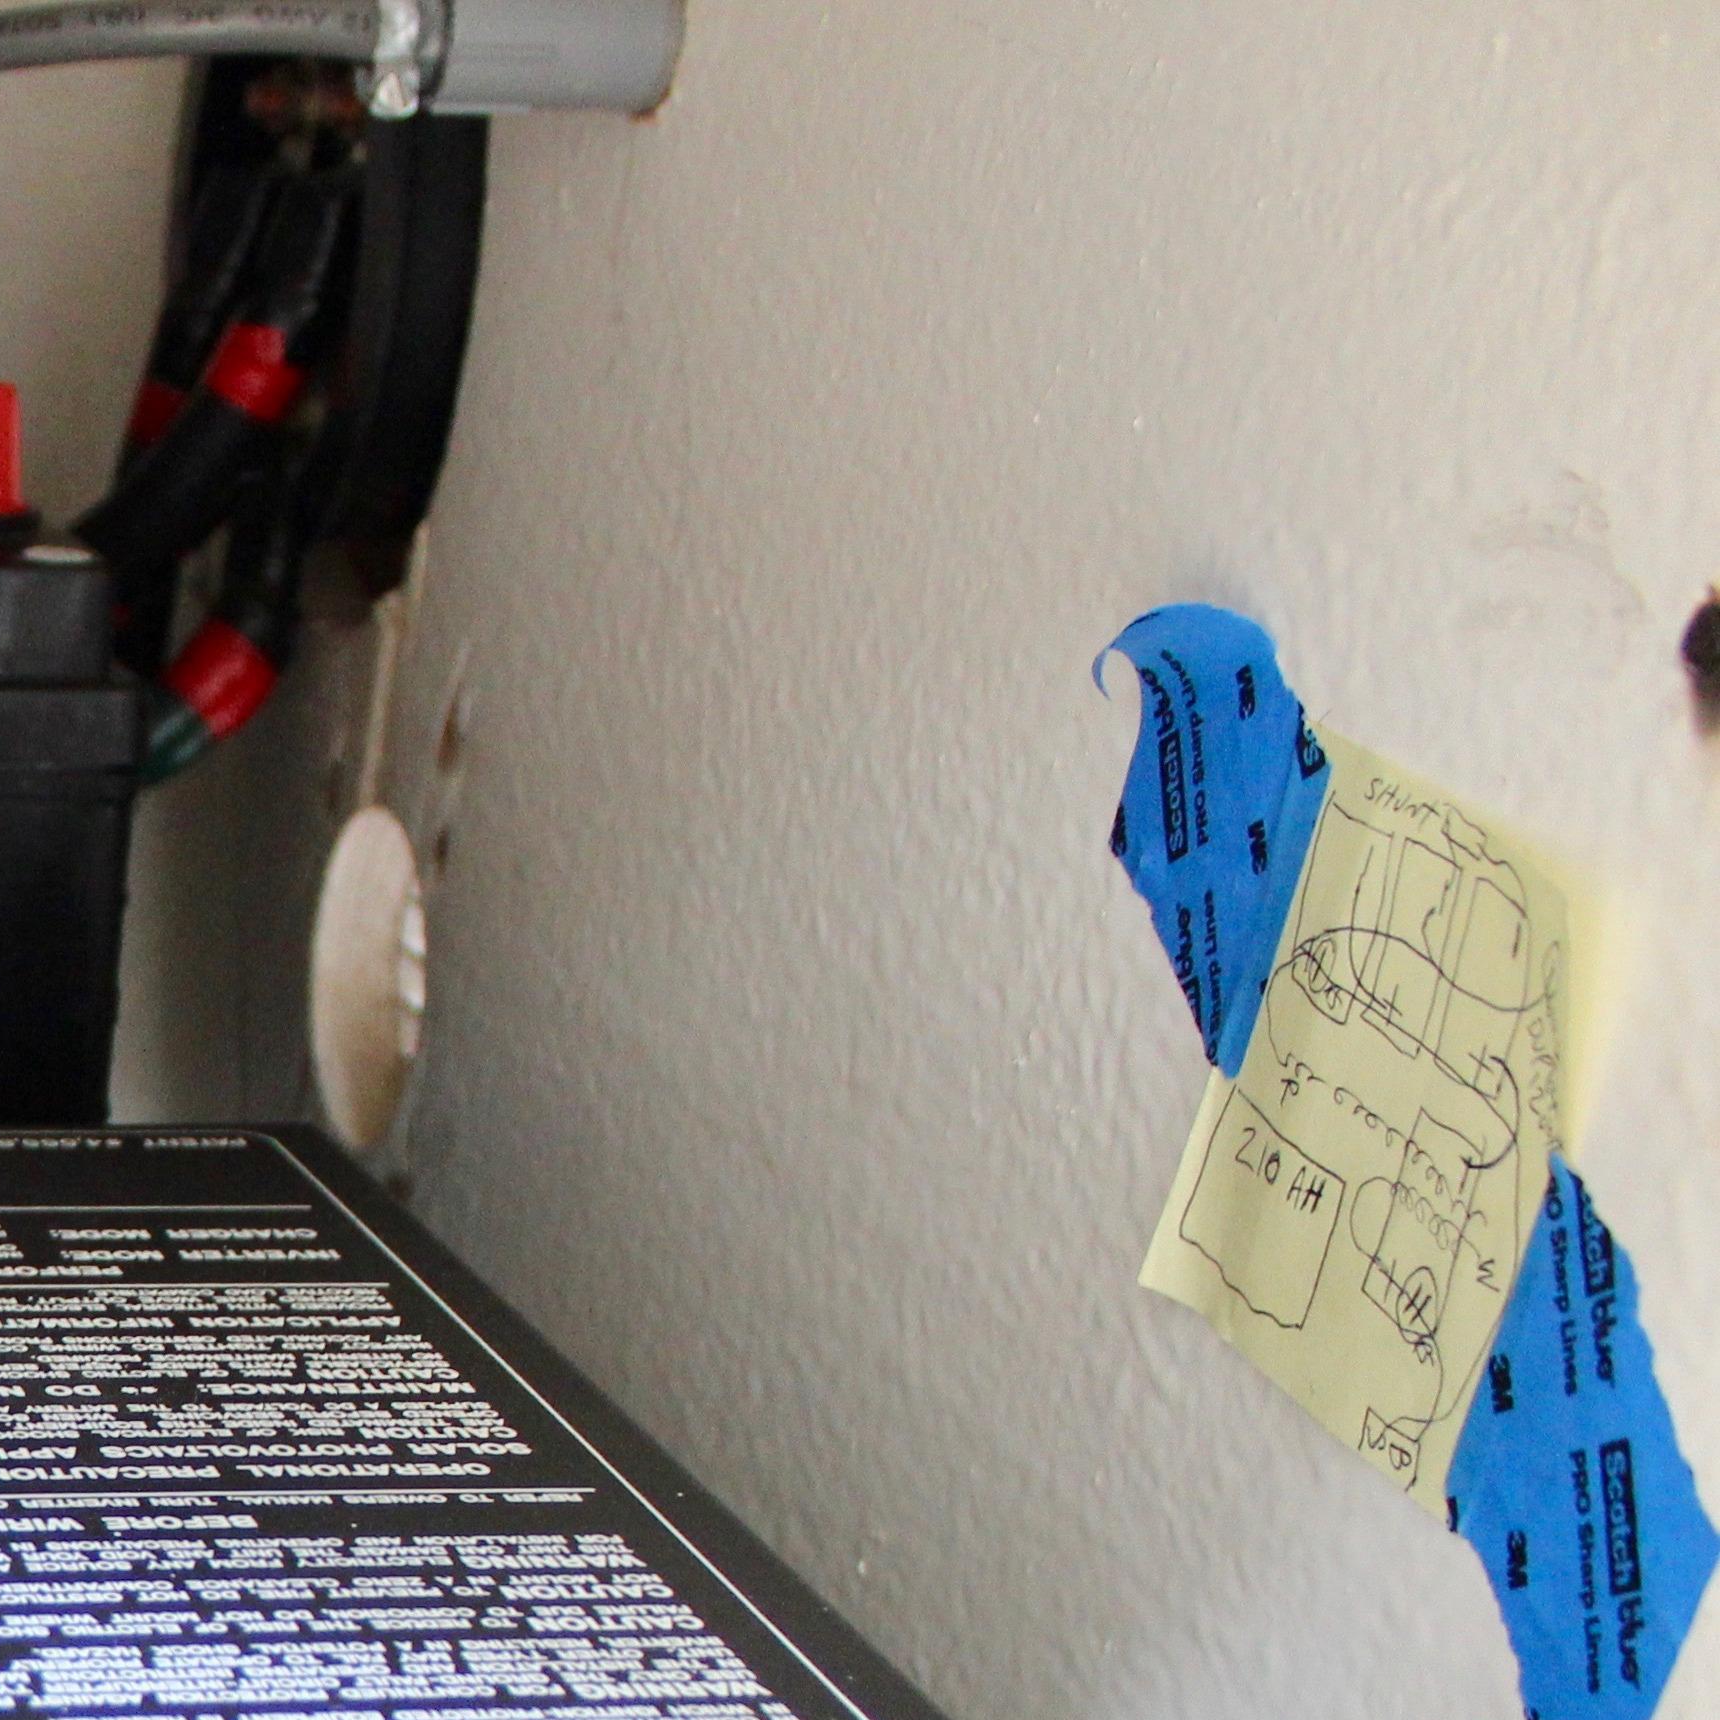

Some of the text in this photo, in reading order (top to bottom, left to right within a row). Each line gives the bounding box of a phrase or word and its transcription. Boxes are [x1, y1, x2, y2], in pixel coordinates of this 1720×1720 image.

[1236, 664, 1257, 720] 3M
[1160, 648, 1210, 846] PRO Sharp Lines
[1161, 732, 1187, 859] Scotch
[1247, 819, 1268, 876] 3M
[1204, 888, 1218, 956] Lines
[1235, 1126, 1328, 1214] 210 AH
[50, 1229, 317, 1239] CHARGER MODE:
[61, 1250, 340, 1260] INVERTER MODE:
[189, 1316, 400, 1327] APPLICATION
[1550, 1228, 1578, 1397] Sharp Lines
[307, 1366, 459, 1379] CAUTION
[45, 1385, 101, 1396] DO
[197, 1383, 476, 1395] MAINTENANCE:
[1488, 1353, 1515, 1414] 3M
[359, 1424, 517, 1439] CAUTION
[100, 1444, 393, 1458] PHOTOVOLTAICS
[407, 1443, 532, 1455] SOLAR
[236, 1463, 490, 1477] OPERATIONAL
[101, 1515, 258, 1530] BEFORE
[460, 1552, 646, 1569] WARNING
[1507, 1530, 1528, 1591] 3M
[1603, 1446, 1646, 1692] Scotch blue
[1569, 1448, 1601, 1695] PRO Sharp Lines
[499, 1582, 673, 1600] CAUTION
[527, 1612, 704, 1631] CAUTION
[571, 1679, 771, 1700] WARNING
